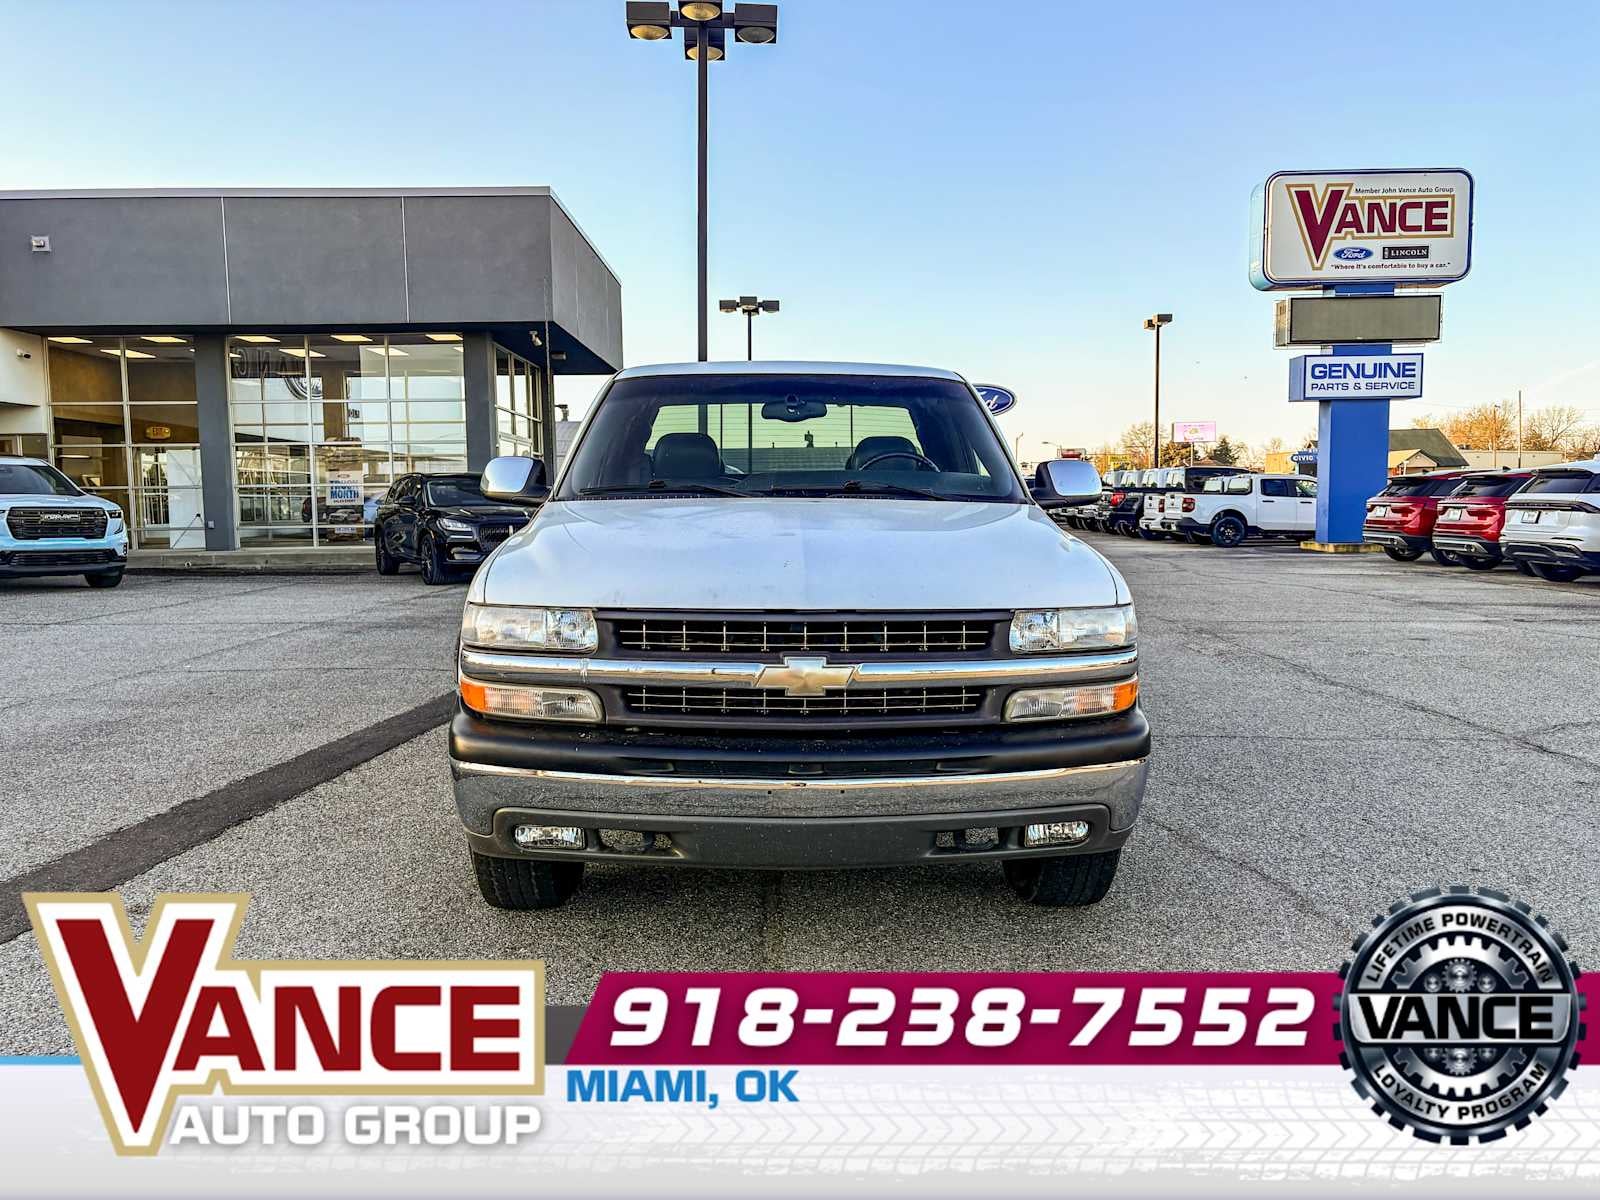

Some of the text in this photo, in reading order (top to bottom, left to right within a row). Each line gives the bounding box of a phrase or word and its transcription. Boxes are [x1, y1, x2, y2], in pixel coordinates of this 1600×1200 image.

[1294, 189, 1449, 263] VANCE
[1341, 248, 1367, 259] Ford
[1417, 262, 1428, 270] buy
[1311, 362, 1417, 379] GENUINE
[1311, 381, 1415, 391] PARTS & SERVICE
[330, 490, 359, 499] MONTH
